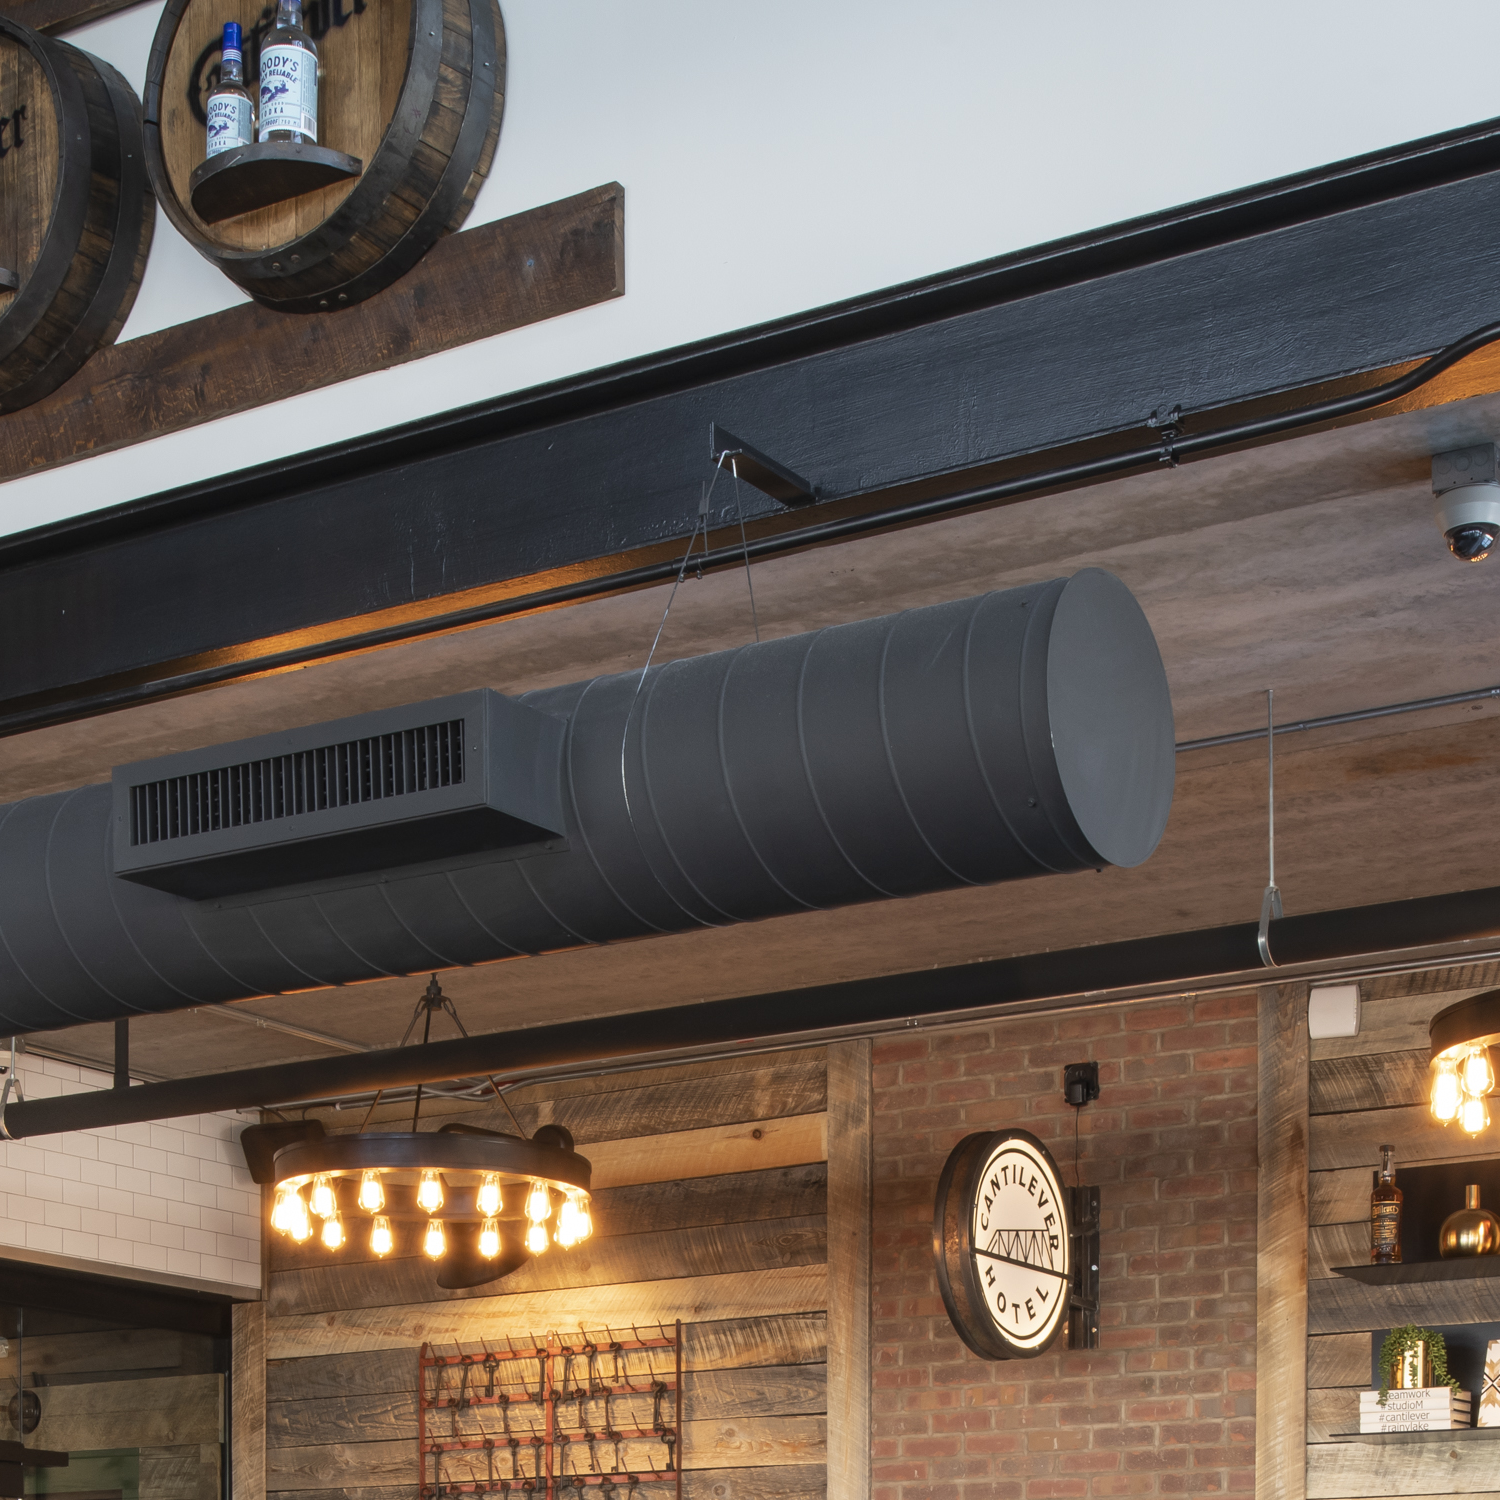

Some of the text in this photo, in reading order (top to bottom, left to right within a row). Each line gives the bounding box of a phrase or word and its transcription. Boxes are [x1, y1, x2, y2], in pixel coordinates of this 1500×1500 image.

[261, 56, 299, 74] OODY'S
[208, 103, 237, 116] OODY'S
[980, 1164, 1059, 1251] CANTILEVER
[985, 1265, 1049, 1324] HOTEL
[1387, 1388, 1431, 1400] eamwork
[1379, 1411, 1430, 1422] #cantilever
